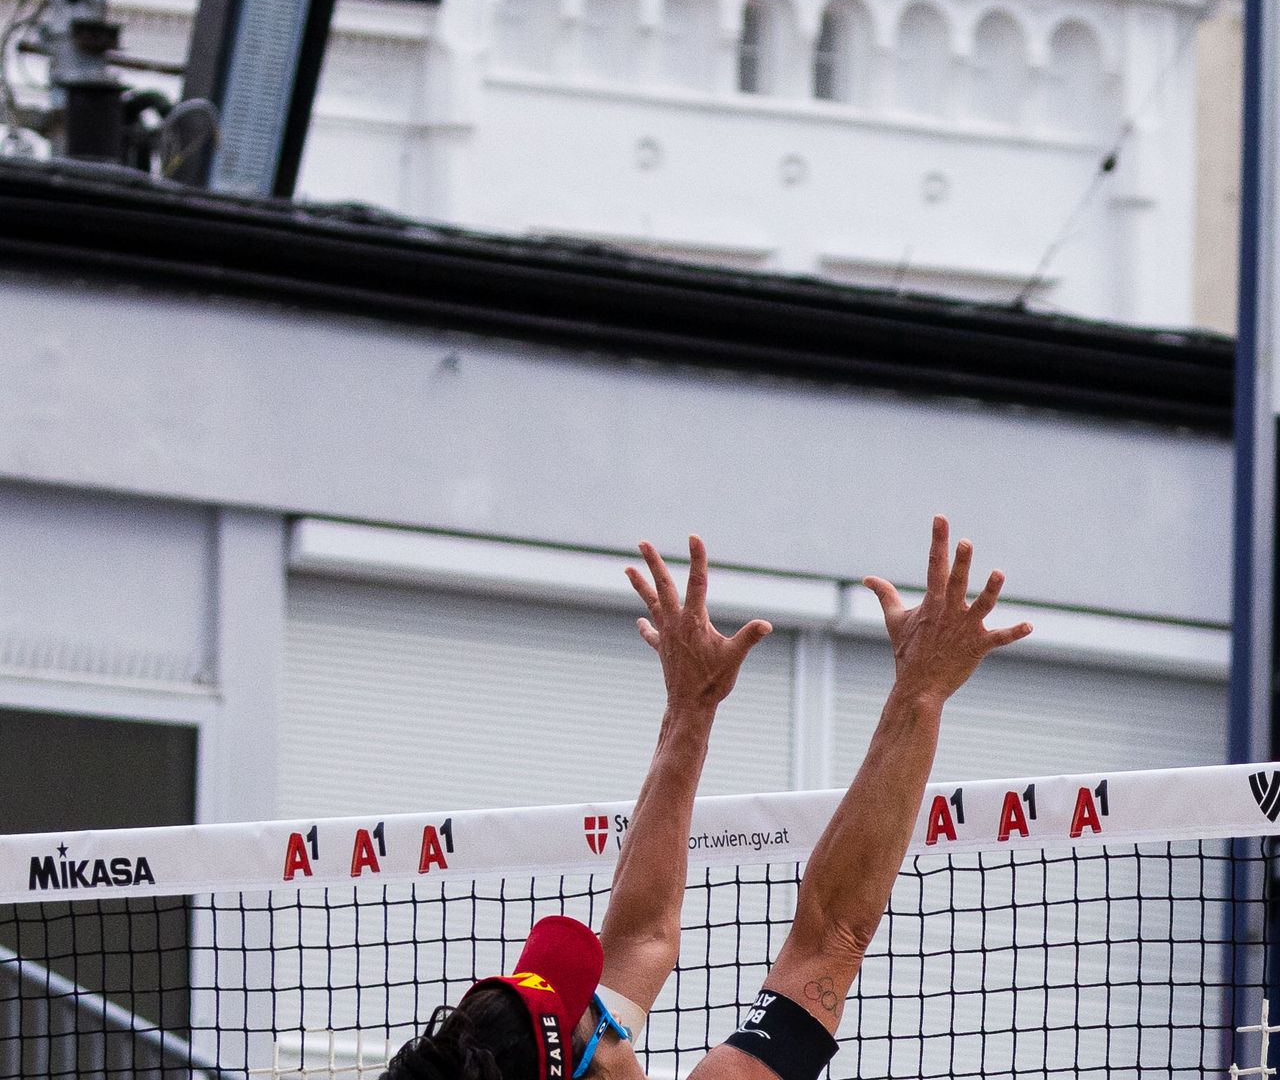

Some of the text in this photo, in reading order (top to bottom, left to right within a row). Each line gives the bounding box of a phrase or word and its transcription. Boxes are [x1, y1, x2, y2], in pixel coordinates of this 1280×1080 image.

[688, 827, 789, 850] ort.wien.gv.at
[926, 780, 1109, 845] A1 A1 A1
[283, 818, 454, 881] A1 A1 A1
